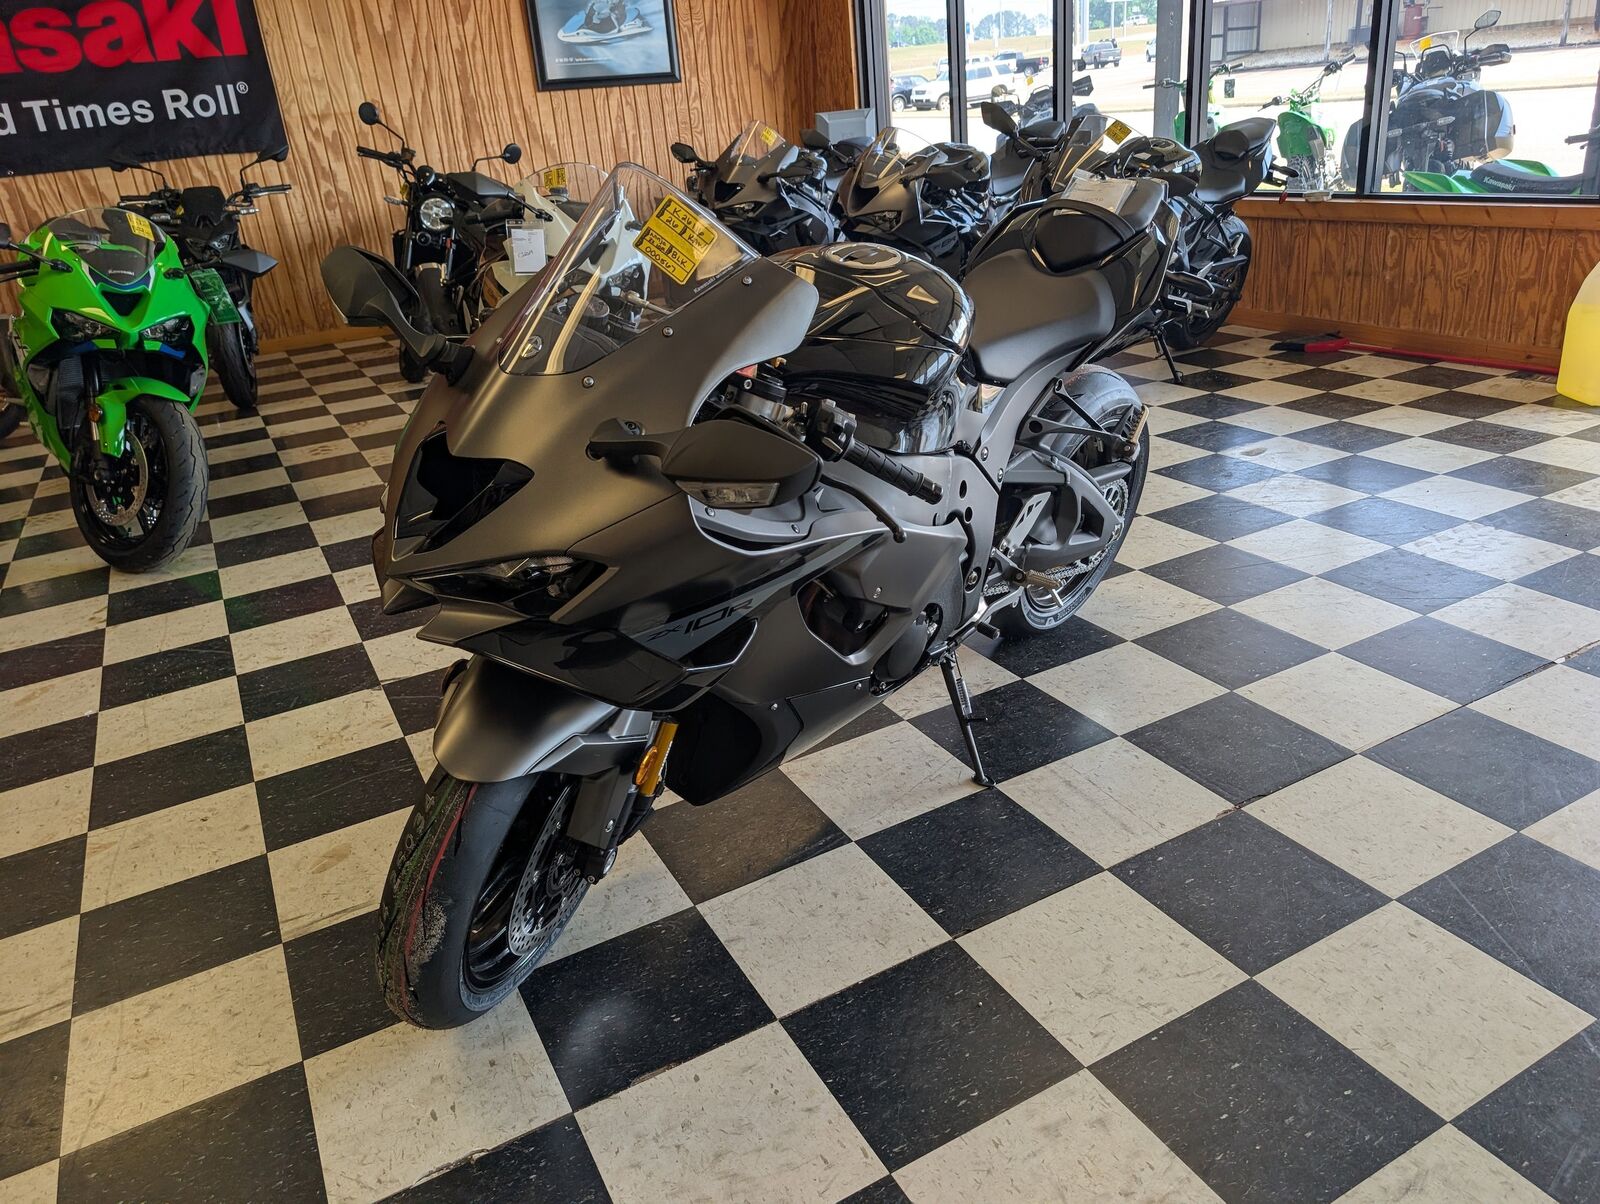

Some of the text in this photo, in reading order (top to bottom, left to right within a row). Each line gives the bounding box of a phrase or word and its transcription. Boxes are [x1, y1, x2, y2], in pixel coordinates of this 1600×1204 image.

[0, 0, 249, 74] saki
[21, 99, 155, 132] Times
[671, 250, 688, 268] BLK
